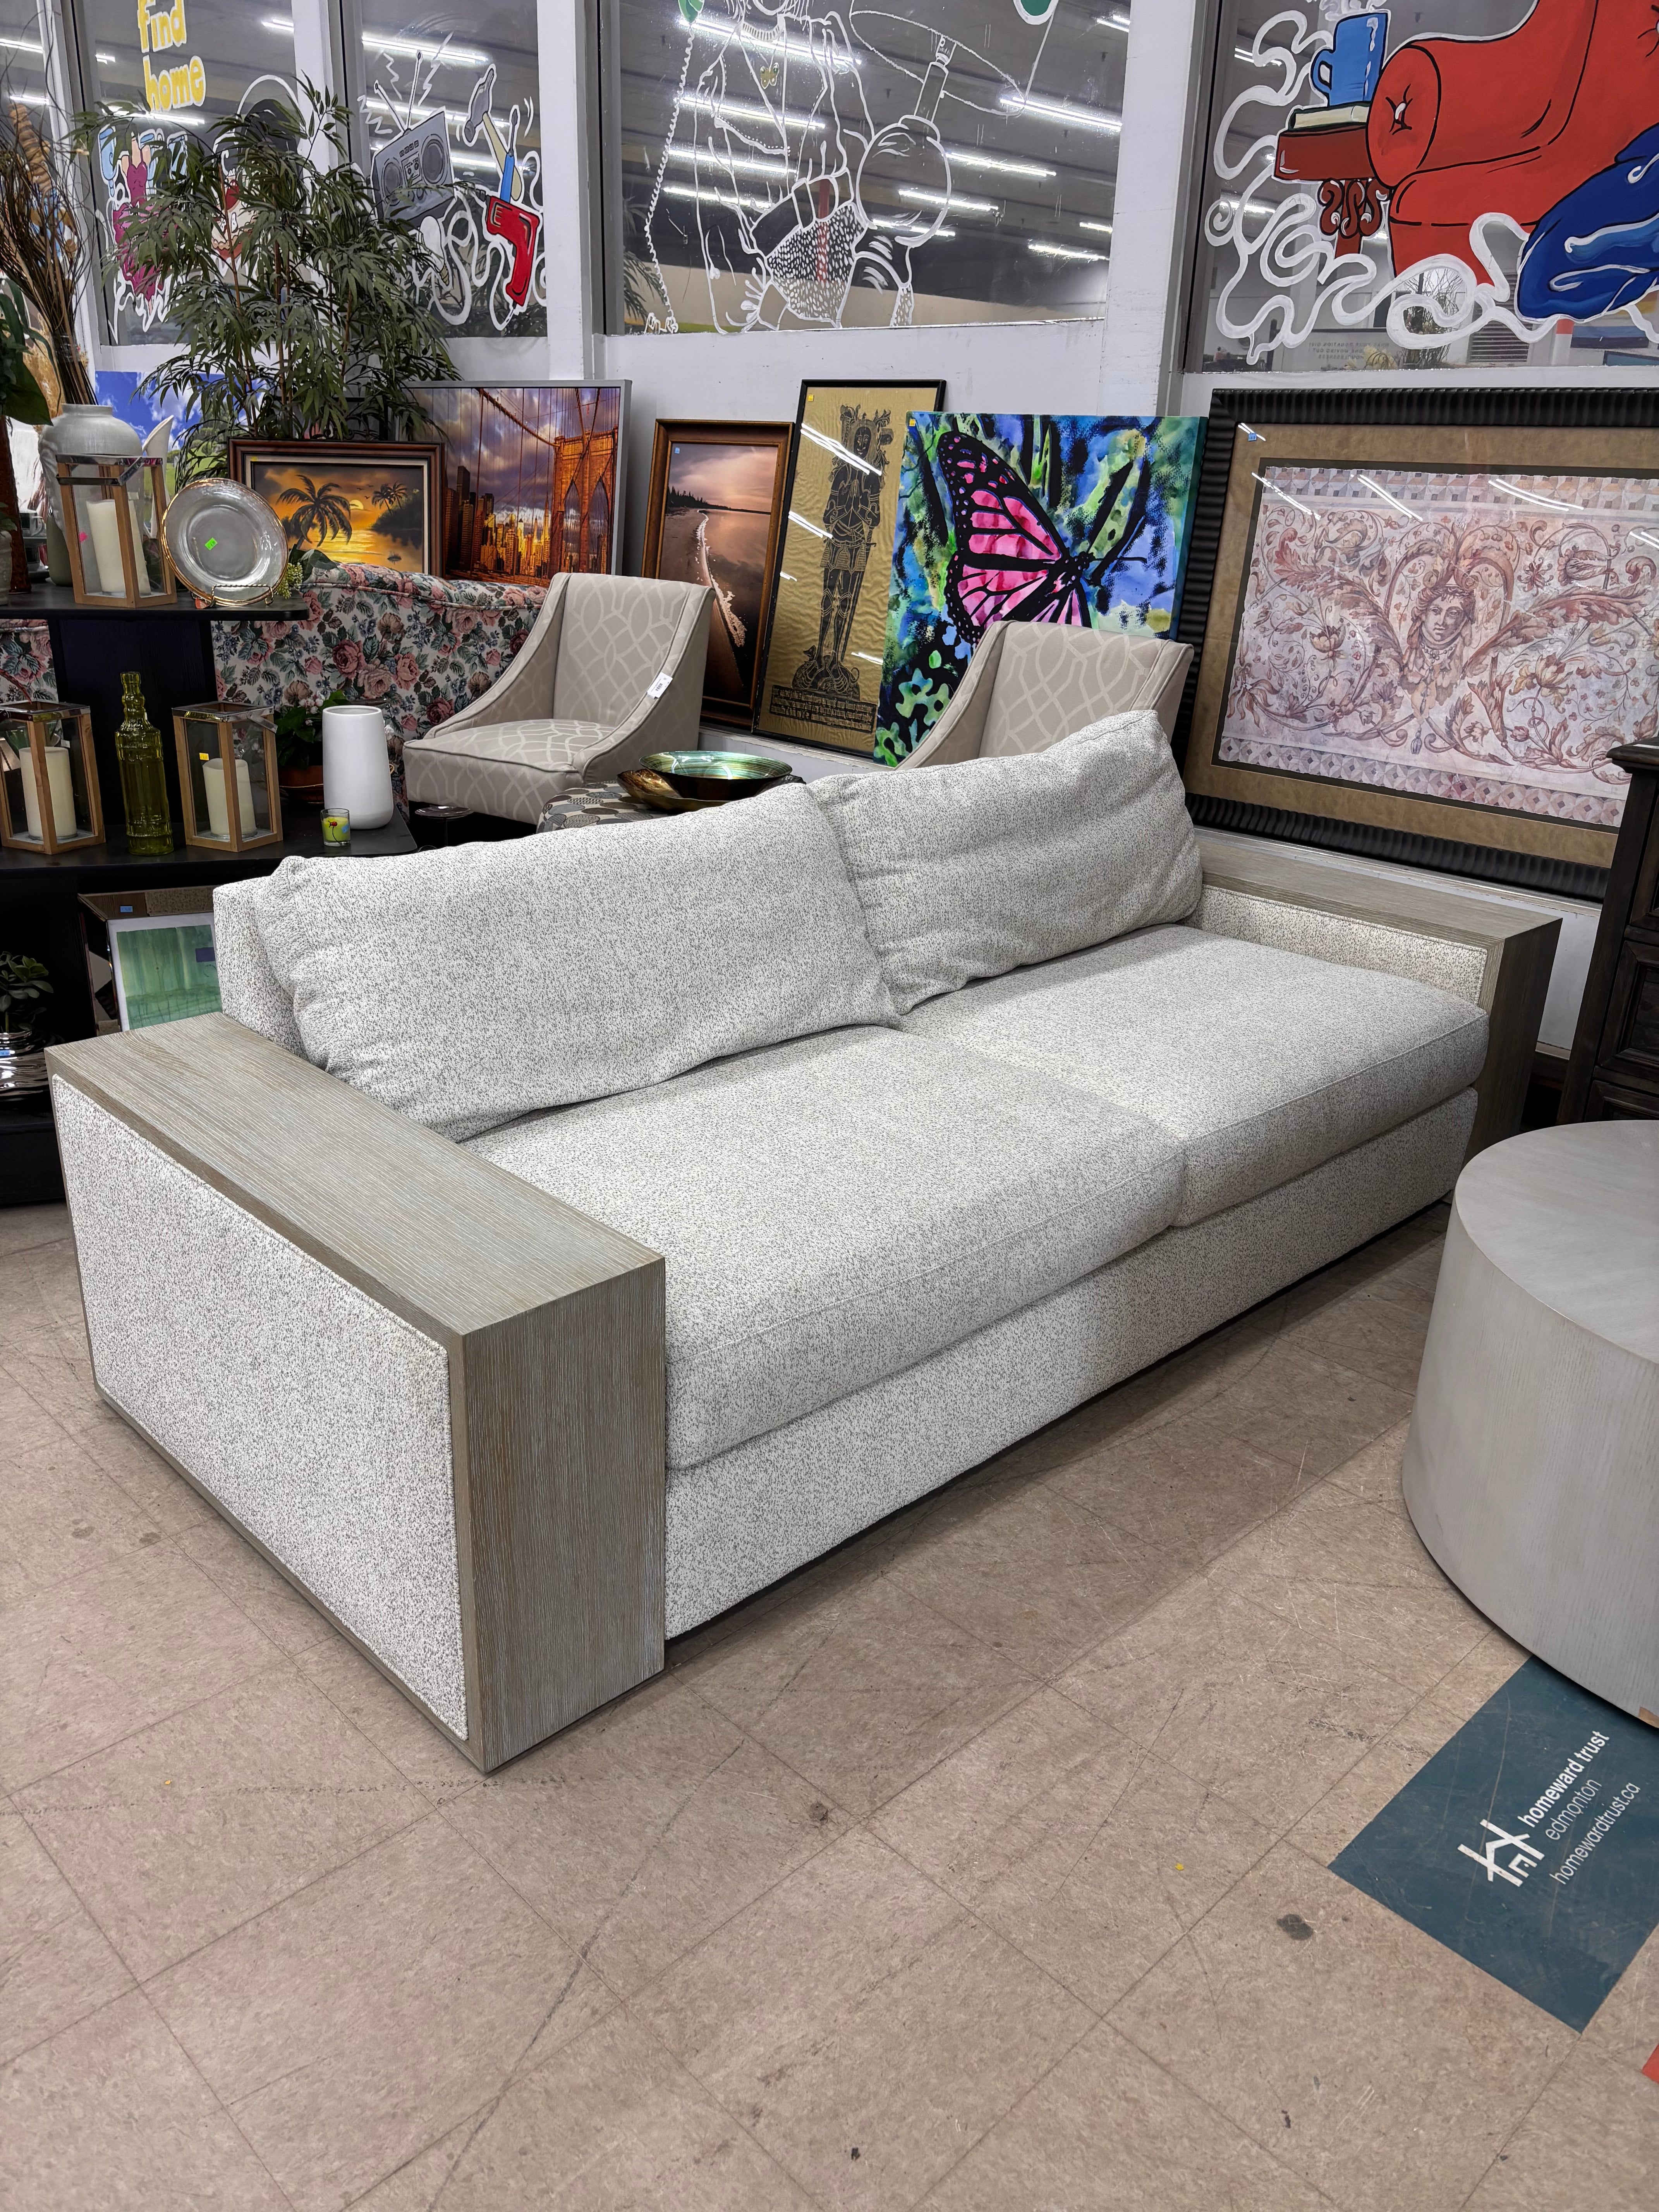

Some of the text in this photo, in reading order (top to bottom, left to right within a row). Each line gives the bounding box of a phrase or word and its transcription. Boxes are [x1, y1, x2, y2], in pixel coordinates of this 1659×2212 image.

[137, 0, 187, 53] find
[143, 55, 206, 112] home
[1517, 1731, 1610, 1828] homeward trust
[1546, 1779, 1602, 1840] edmonton
[1549, 1783, 1641, 1885] homewardtrust.ca
